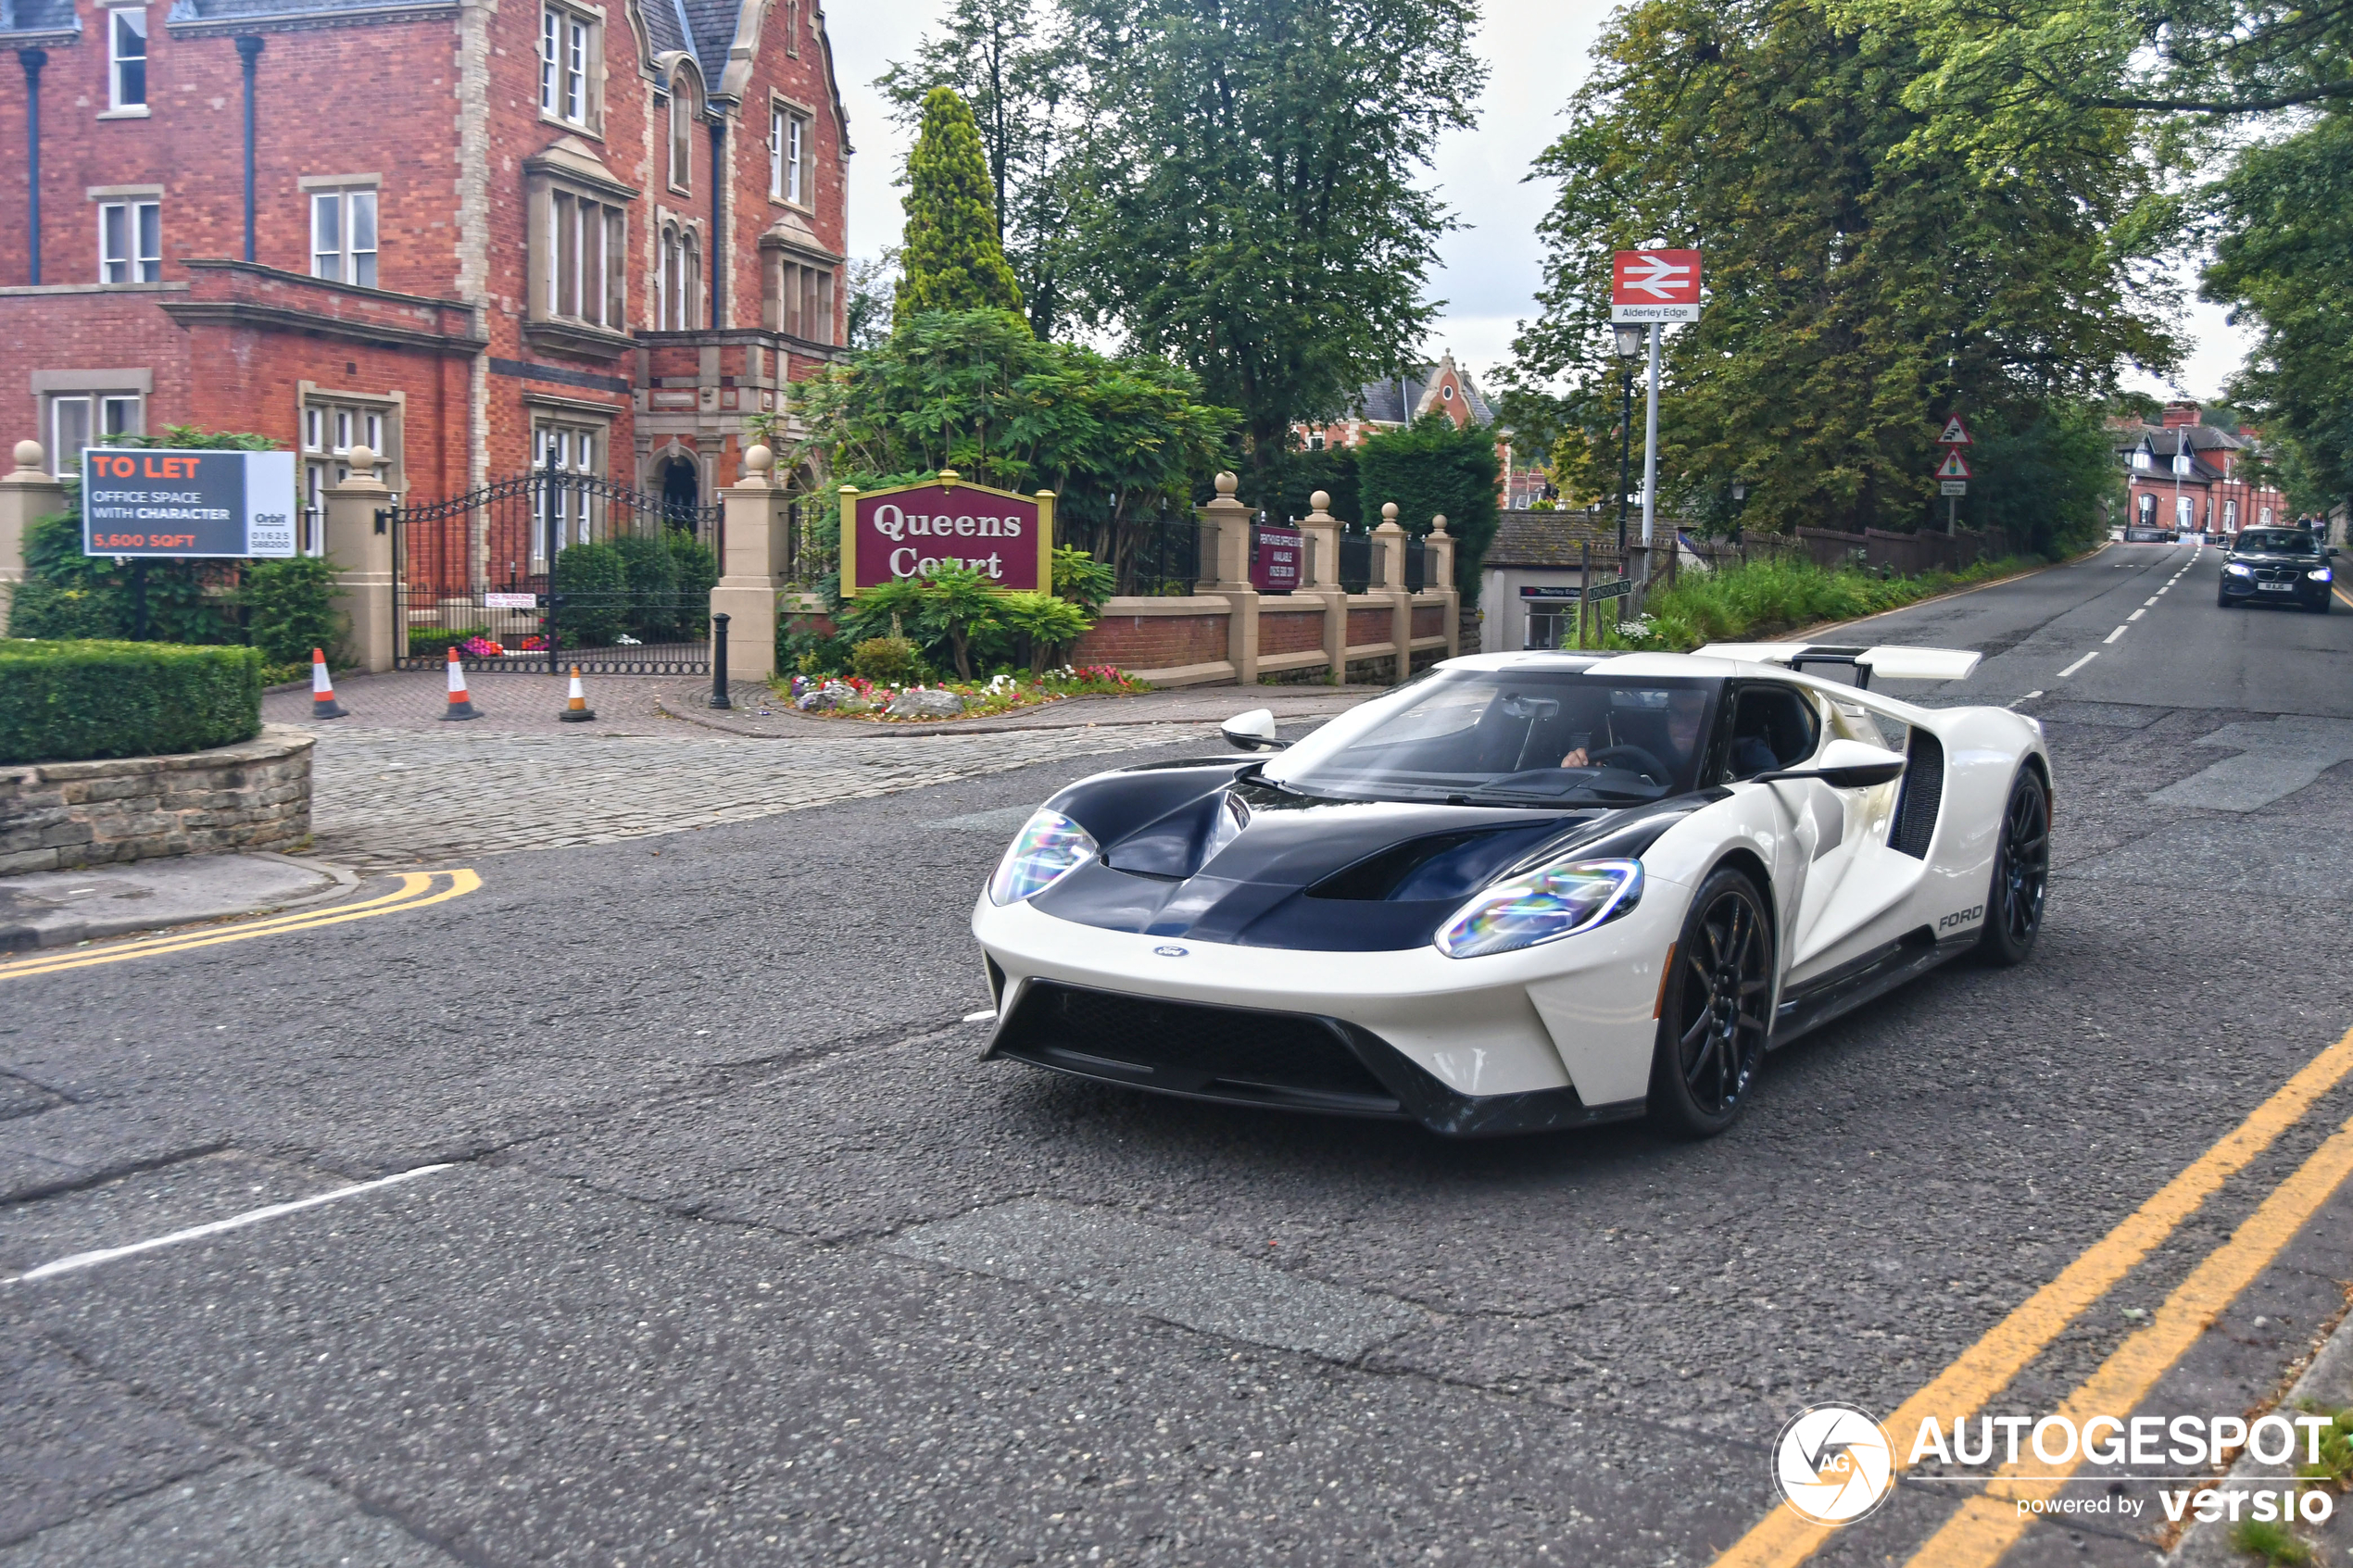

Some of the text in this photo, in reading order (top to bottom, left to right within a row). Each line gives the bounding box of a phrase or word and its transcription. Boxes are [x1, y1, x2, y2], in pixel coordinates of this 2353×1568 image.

[1622, 307, 1688, 318] Alderley Edge
[92, 457, 200, 479] TO LET
[93, 491, 201, 504] OFFICE SPACE
[93, 507, 230, 521] WITH CHARACTER
[255, 513, 286, 523] Orbit
[874, 504, 1022, 541] Queens
[94, 534, 195, 549] 5,600 SQFT
[251, 540, 291, 548] 588200
[1589, 582, 1629, 600] LONDON RD
[1939, 904, 1983, 932] FORD
